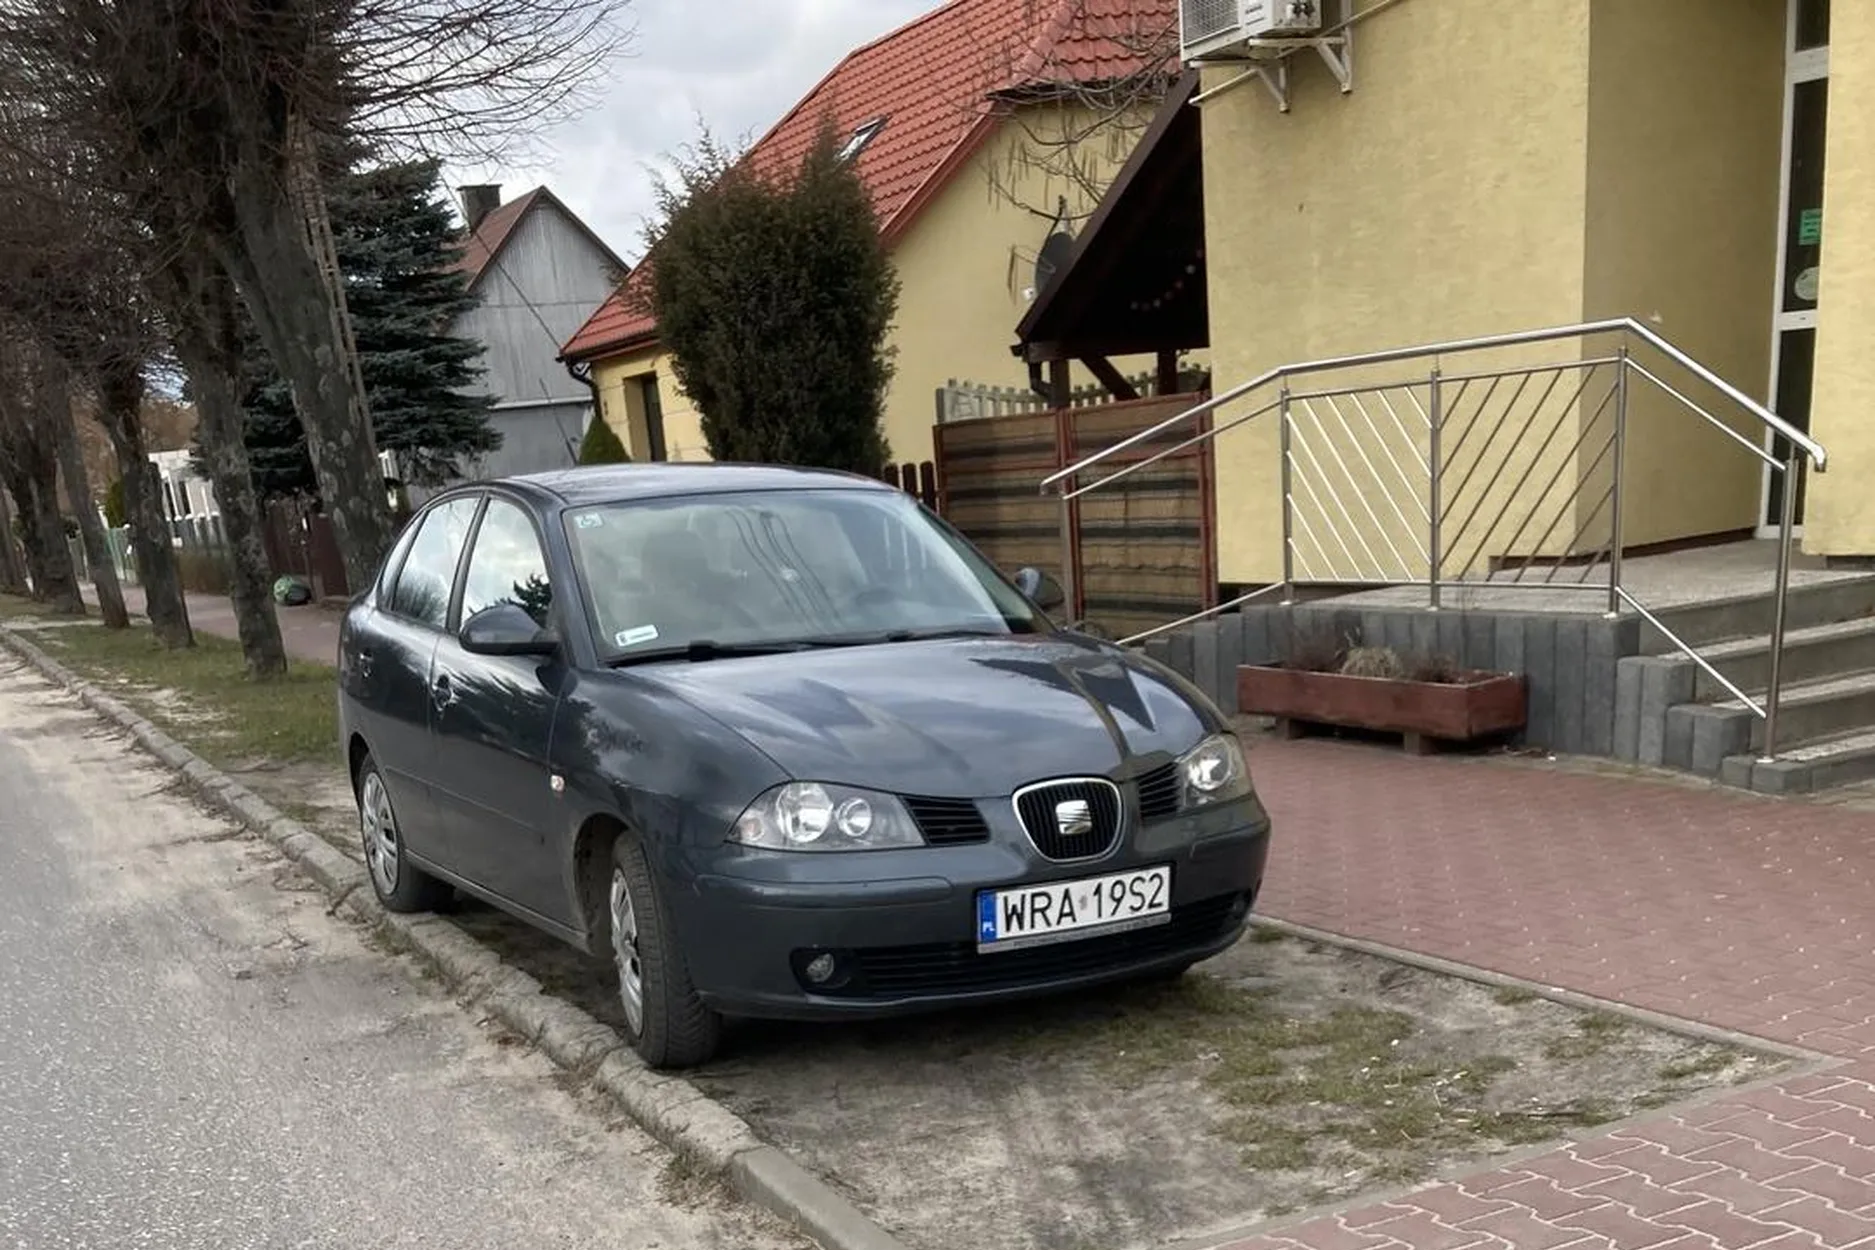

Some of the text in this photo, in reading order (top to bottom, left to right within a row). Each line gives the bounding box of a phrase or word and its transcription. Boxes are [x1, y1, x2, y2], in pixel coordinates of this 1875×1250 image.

[1003, 873, 1164, 932] WRA 19S2
[983, 921, 995, 932] PL
